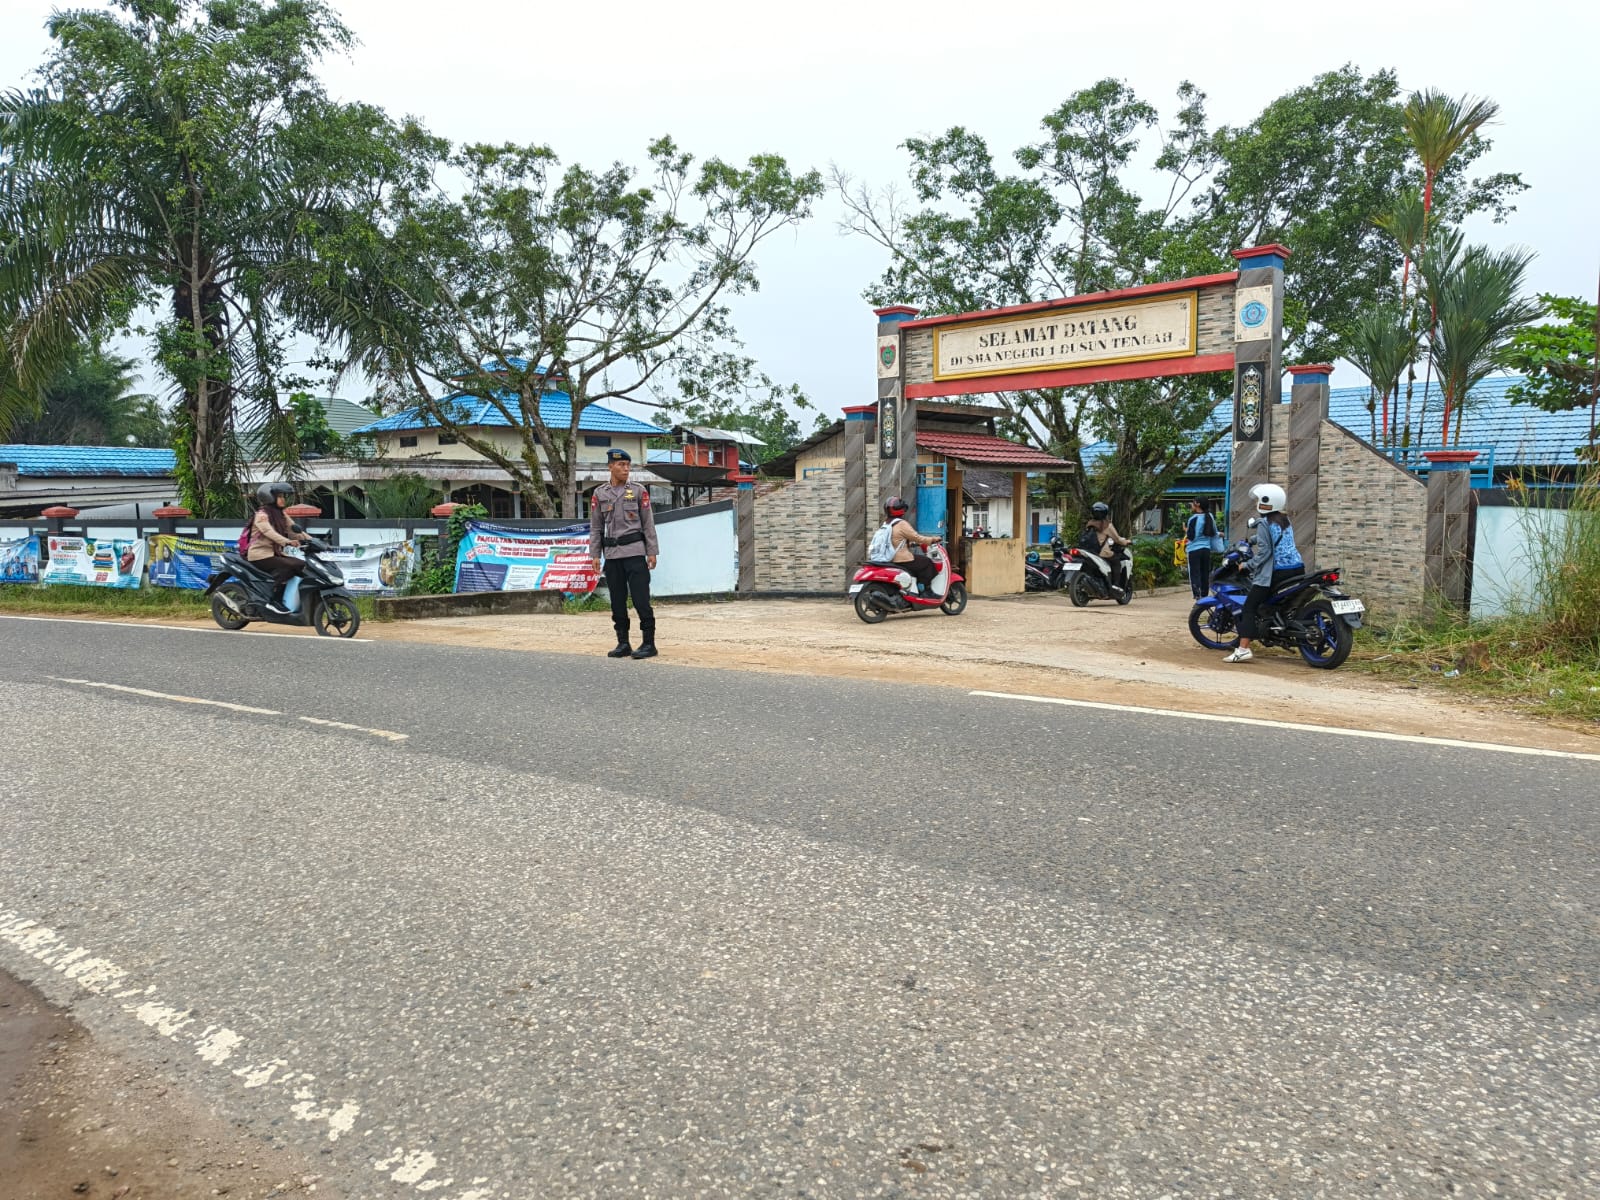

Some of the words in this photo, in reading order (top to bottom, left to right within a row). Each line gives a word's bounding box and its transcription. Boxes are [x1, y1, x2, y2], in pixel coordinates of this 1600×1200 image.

[979, 324, 1058, 348] SELAMAT
[1064, 315, 1137, 337] DATANG
[995, 345, 1045, 361] NEGERI
[1060, 339, 1106, 355] DUSUN
